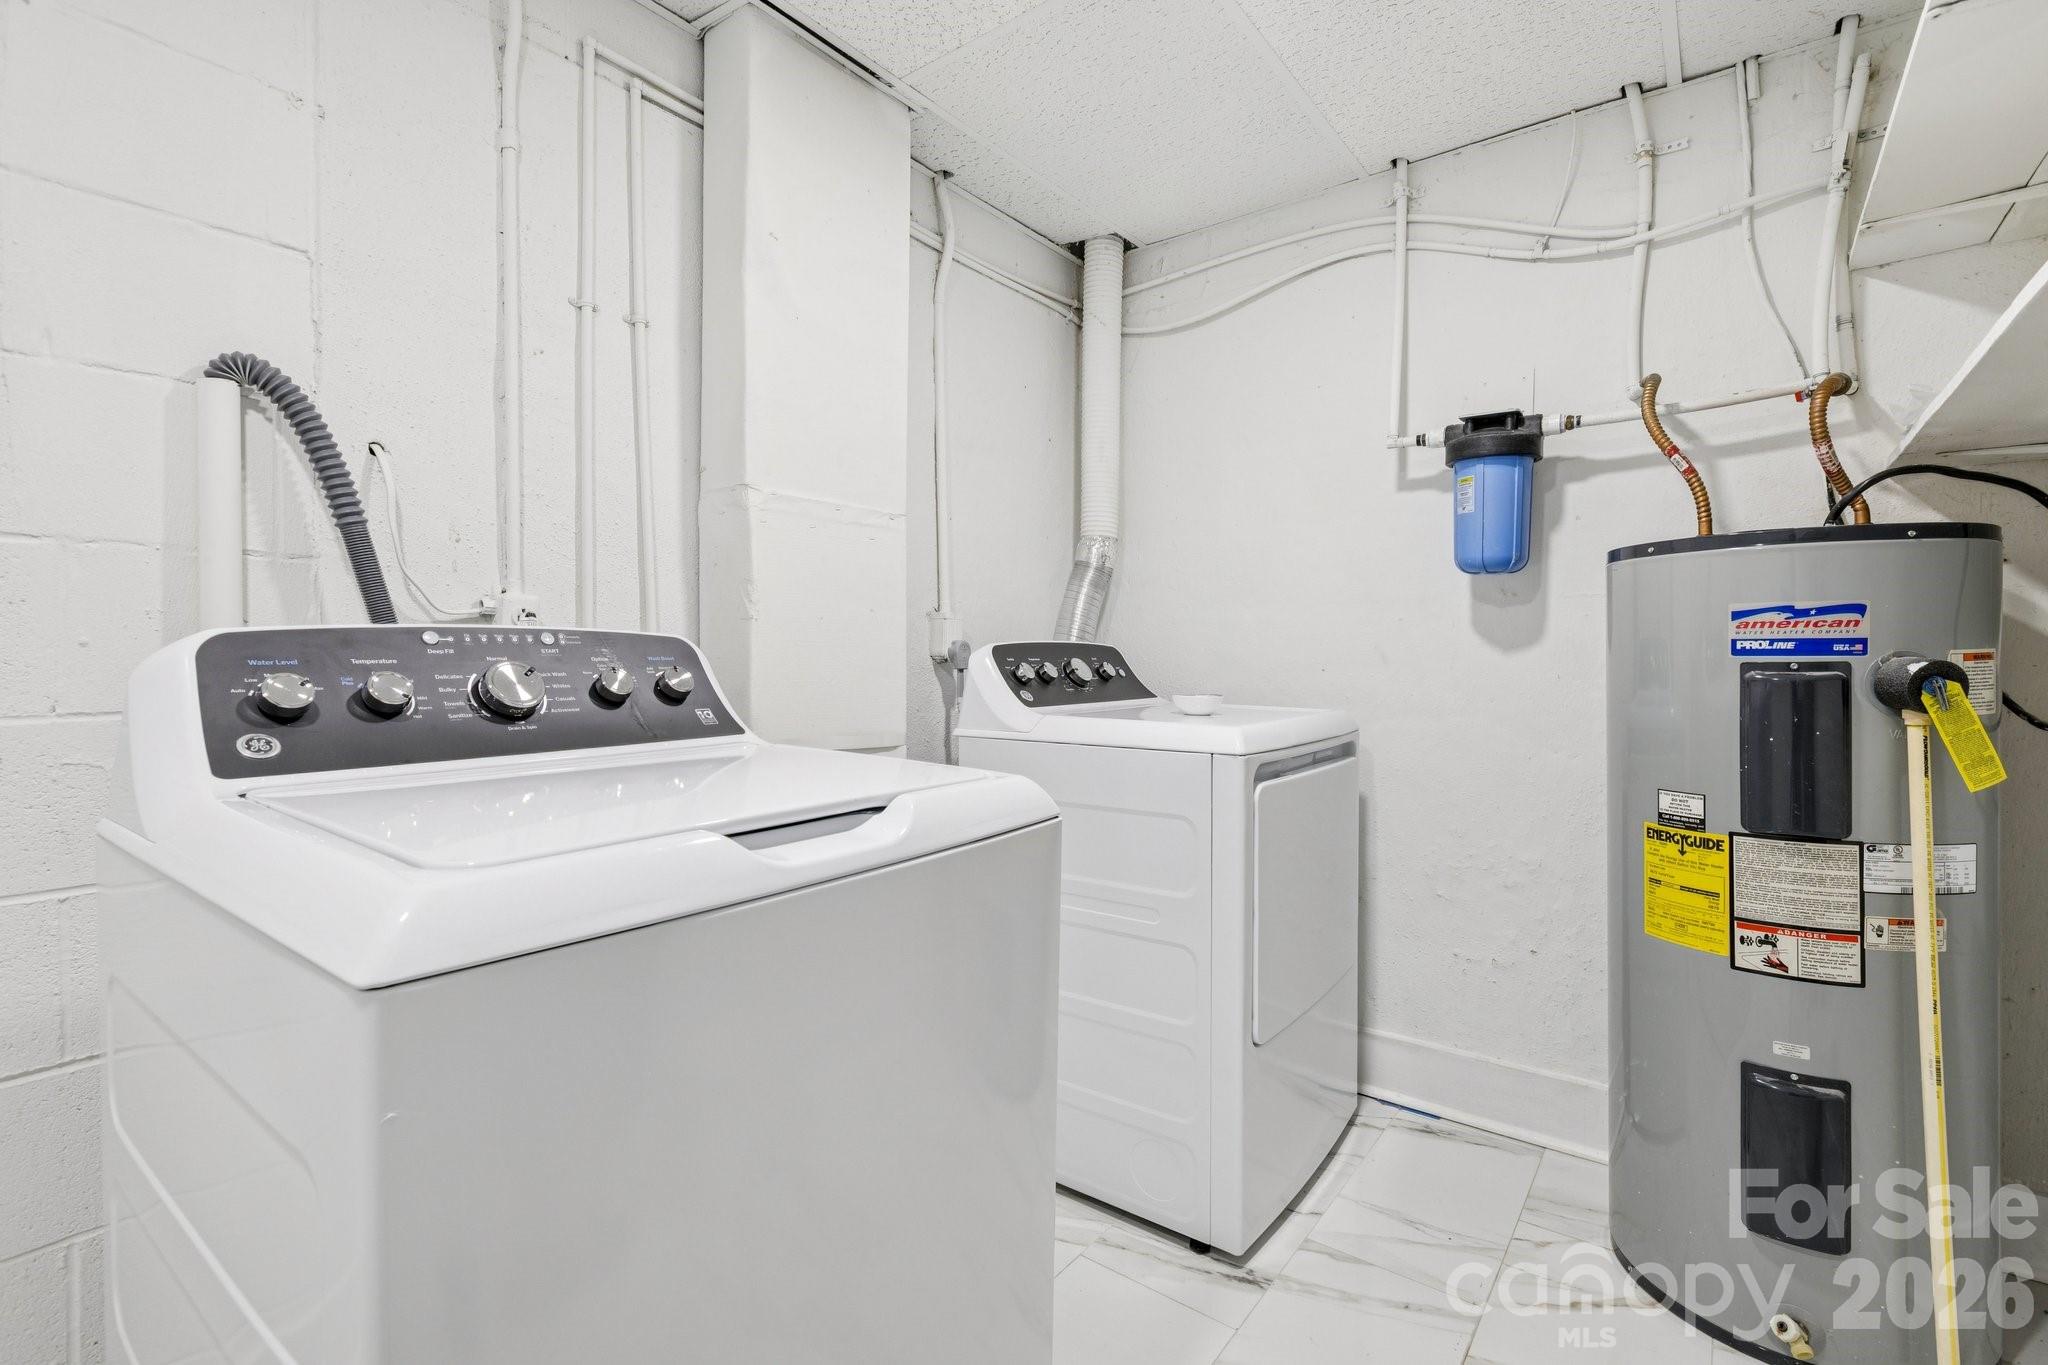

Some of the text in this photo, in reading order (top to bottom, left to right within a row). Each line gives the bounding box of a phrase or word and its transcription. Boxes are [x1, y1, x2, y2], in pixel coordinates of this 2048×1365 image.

[1736, 619, 1860, 629] american
[1647, 827, 1725, 852] ENERGYGUIDE
[1784, 930, 1827, 939] DANGER
